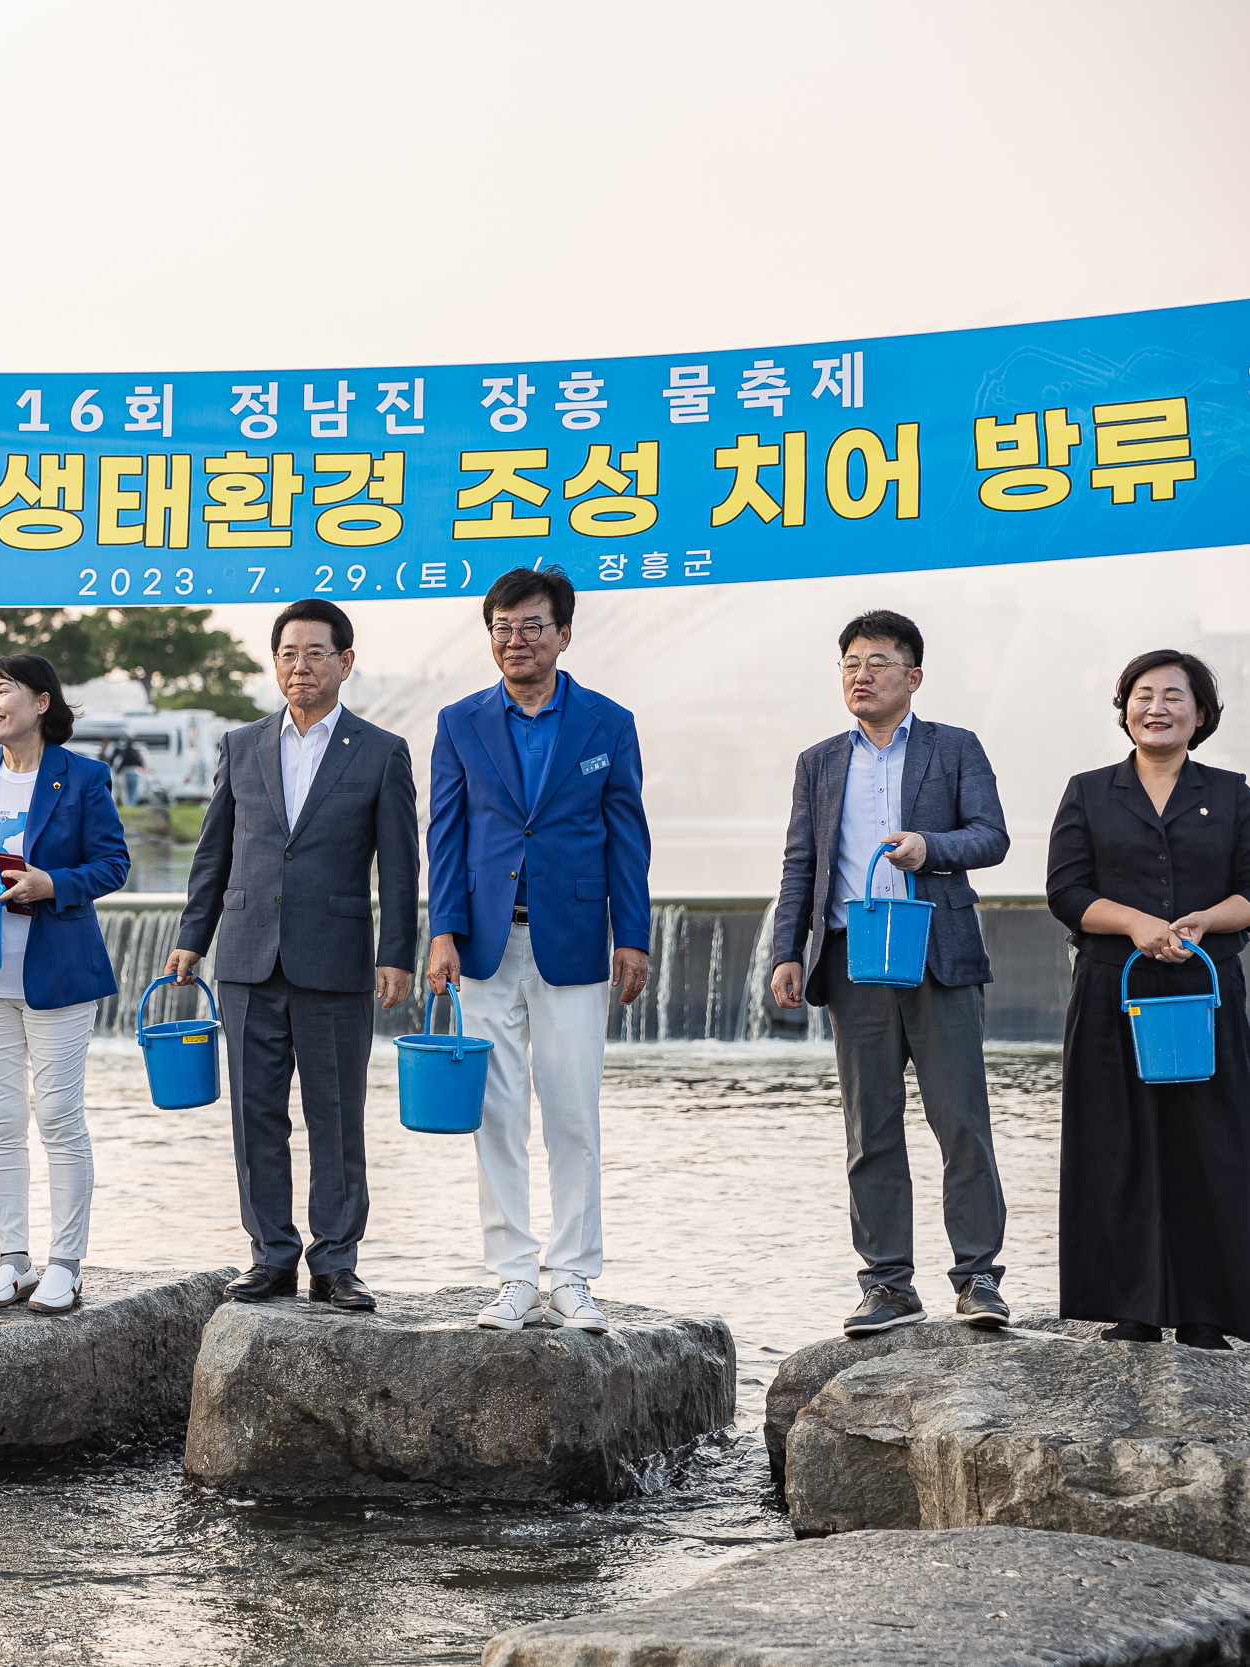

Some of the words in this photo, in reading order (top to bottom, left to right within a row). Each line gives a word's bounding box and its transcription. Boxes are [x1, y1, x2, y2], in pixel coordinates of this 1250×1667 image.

[230, 378, 425, 439] 정남진
[481, 371, 607, 432] 장흥
[661, 351, 865, 424] 물축제
[451, 440, 660, 541] 조성
[710, 421, 921, 529] 치어
[973, 396, 1197, 513] 방류
[78, 567, 213, 596] 2023.
[247, 566, 281, 594] 7.
[314, 559, 472, 593] 29.(토)
[598, 553, 713, 582] 장흥군
